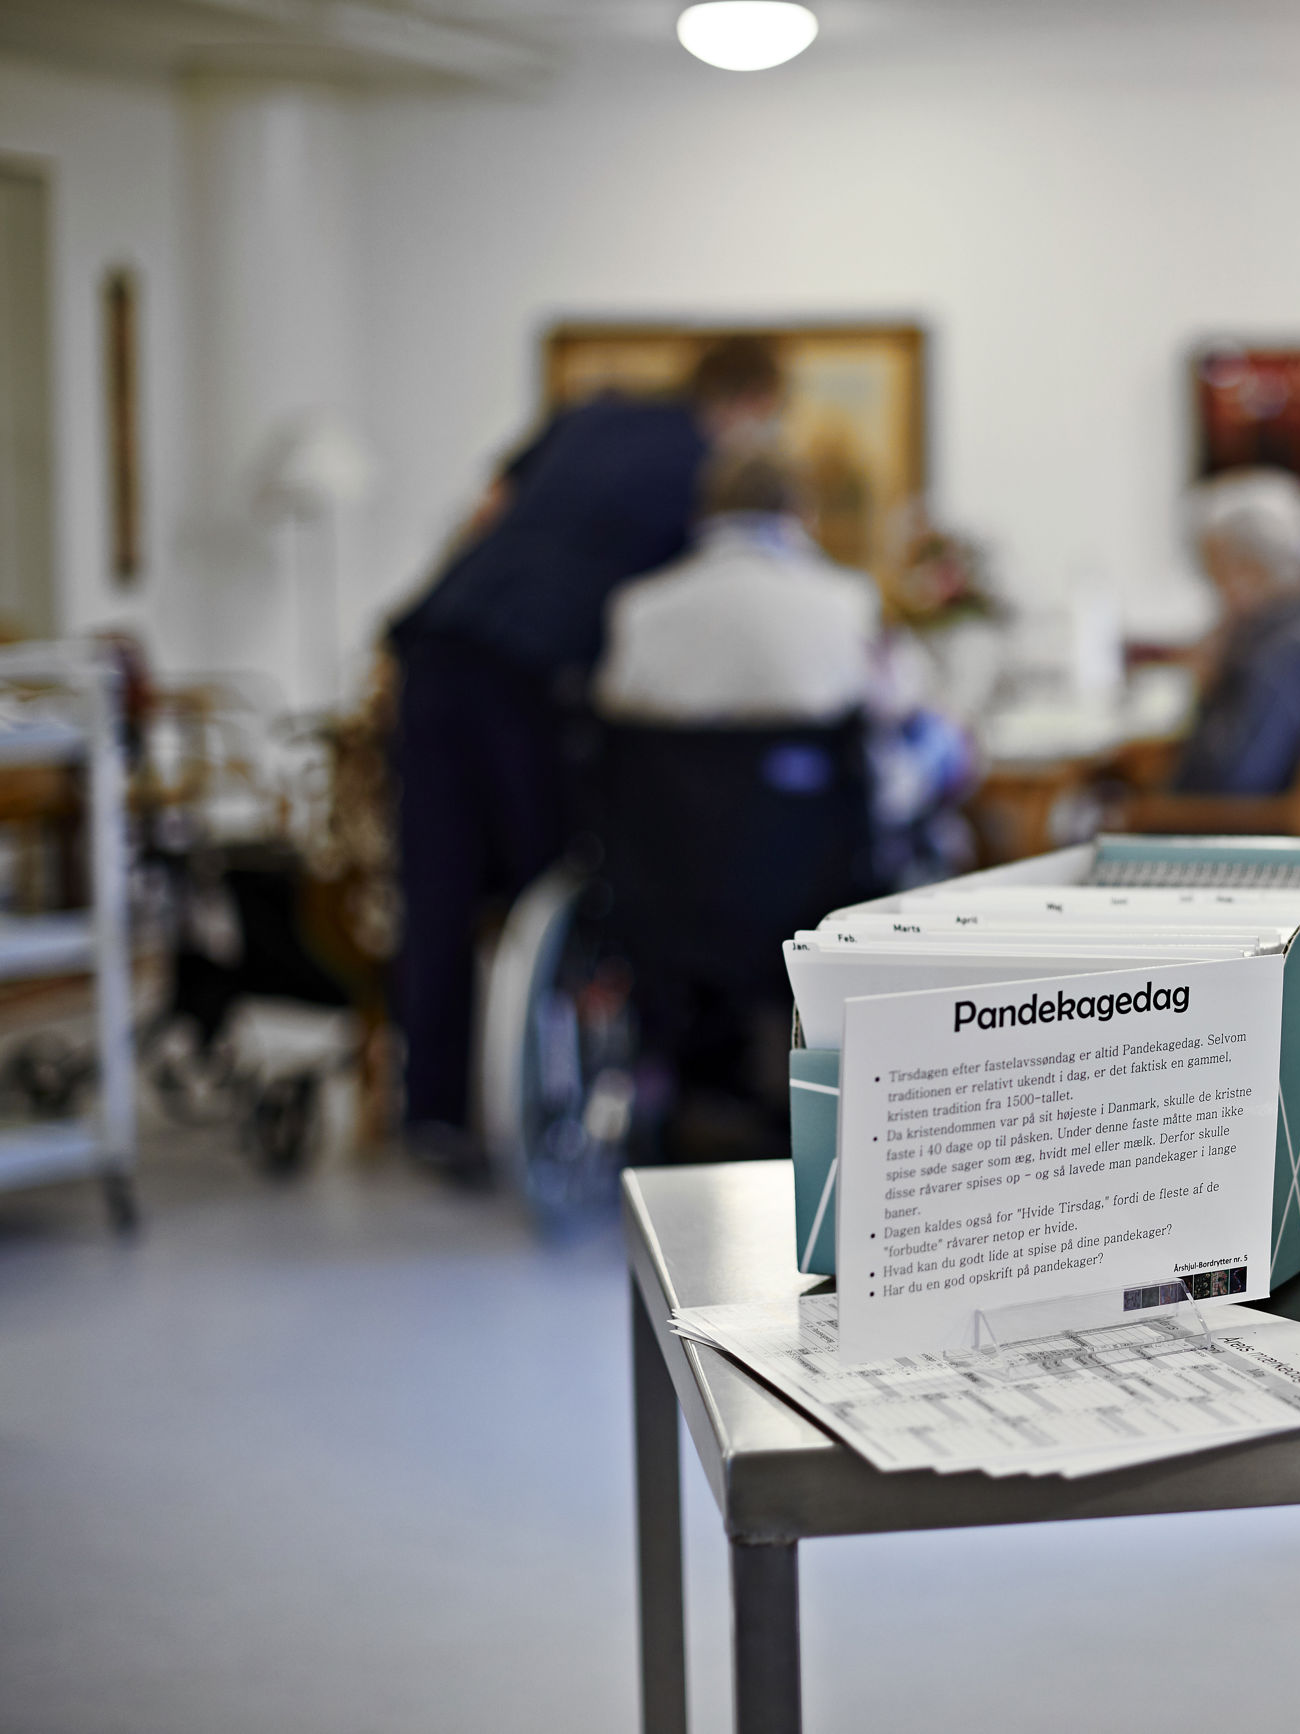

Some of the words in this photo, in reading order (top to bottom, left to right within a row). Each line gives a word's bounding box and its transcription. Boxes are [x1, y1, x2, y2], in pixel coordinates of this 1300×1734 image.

[837, 933, 857, 943] Feb.
[893, 924, 921, 933] Marts
[955, 916, 978, 925] April
[792, 942, 810, 951] Jan.
[954, 982, 1190, 1032] Pandekagedag
[887, 1086, 952, 1103] traditionen
[954, 1084, 968, 1095] er
[971, 1077, 1013, 1093] relativt
[1017, 1072, 1055, 1087] ukendt
[1066, 1069, 1090, 1082] dag,
[1093, 1068, 1106, 1078] er
[1109, 1064, 1126, 1076] det
[1130, 1058, 1167, 1074] faktisk
[1170, 1059, 1184, 1068] en
[1187, 1051, 1231, 1068] gammel,
[888, 1067, 948, 1083] Tirsdagen
[951, 1062, 981, 1076] efter
[984, 1051, 1076, 1072] fastelavssøndag
[1079, 1051, 1092, 1061] er
[1094, 1045, 1118, 1059] altid
[1122, 1037, 1203, 1056] Pandekagedag.
[1207, 1033, 1246, 1045] Selvom
[886, 1108, 928, 1122] kristen
[932, 1100, 981, 1117] tradition
[985, 1098, 1001, 1110] fra
[1007, 1090, 1073, 1108] 1500-tallet.
[886, 1129, 903, 1142] Da
[906, 1120, 996, 1139] kristendommen
[999, 1117, 1019, 1127] var
[1022, 1112, 1035, 1127] på
[1039, 1110, 1052, 1123] sit
[1056, 1107, 1096, 1121] højeste
[1107, 1097, 1159, 1114] Danmark,
[1163, 1093, 1194, 1107] skulle
[1198, 1090, 1211, 1102] de
[1214, 1087, 1252, 1100] kristne
[885, 1167, 916, 1182] spise
[920, 1162, 947, 1176] søde
[951, 1159, 984, 1172] sager
[987, 1156, 1011, 1168] som
[1014, 1153, 1034, 1164] æg,
[1039, 1146, 1067, 1160] hvidt
[1071, 1142, 1090, 1156] mel
[1094, 1140, 1120, 1153] eller
[1123, 1135, 1155, 1149] mælk.
[1159, 1130, 1195, 1144] Derfor
[1198, 1125, 1230, 1139] skulle
[886, 1148, 916, 1162] faste
[927, 1142, 942, 1156] 40
[945, 1141, 973, 1154] dage
[976, 1139, 992, 1150] op
[995, 1134, 1006, 1147] til
[1010, 1131, 1052, 1147] påsken.
[1057, 1125, 1092, 1139] Under
[1095, 1122, 1128, 1134] denne
[1132, 1117, 1158, 1129] faste
[1162, 1112, 1192, 1126] måtte
[1196, 1110, 1218, 1121] man
[1221, 1105, 1244, 1118] ikke
[884, 1187, 916, 1200] disse
[919, 1181, 963, 1196] råvarer
[966, 1175, 1002, 1190] spises
[1006, 1174, 1020, 1184] op
[1035, 1170, 1049, 1180] og
[1053, 1165, 1065, 1177] så
[1069, 1160, 1105, 1175] lavede
[1108, 1159, 1131, 1170] man
[1135, 1149, 1198, 1168] pandekager
[1208, 1144, 1236, 1156] lange
[883, 1225, 920, 1239] Dagen
[924, 1218, 962, 1233] kaldes
[965, 1212, 992, 1228] også
[996, 1210, 1013, 1223] for
[1017, 1204, 1054, 1219] "Hvide
[1058, 1195, 1109, 1214] Tirsdag,"
[1113, 1191, 1138, 1206] fordi
[1142, 1190, 1155, 1202] de
[1159, 1187, 1189, 1199] fleste
[1192, 1182, 1204, 1195] af
[1206, 1181, 1219, 1192] de
[884, 1206, 920, 1220] baner.
[883, 1238, 943, 1258] "forbudte"
[946, 1234, 989, 1249] råvarer
[992, 1230, 1024, 1242] netop
[1028, 1227, 1040, 1237] er
[1044, 1220, 1077, 1235] hvide.
[883, 1261, 913, 1278] Hvad
[917, 1260, 938, 1273] kan
[941, 1256, 955, 1269] du
[959, 1252, 984, 1268] godt
[988, 1248, 1009, 1262] lide
[1013, 1248, 1024, 1258] at
[1027, 1242, 1056, 1257] spise
[1060, 1238, 1072, 1253] på
[1076, 1236, 1100, 1248] dine
[1103, 1223, 1172, 1246] pandekager?
[883, 1284, 905, 1297] Har
[908, 1280, 922, 1293] du
[926, 1280, 940, 1290] en
[943, 1273, 965, 1290] god
[968, 1266, 1013, 1285] opskrift
[1017, 1263, 1029, 1278] på
[1033, 1252, 1104, 1276] pandekager?
[1173, 1258, 1232, 1272] Årshjul-Bordrytter
[1243, 1254, 1248, 1262] 5
